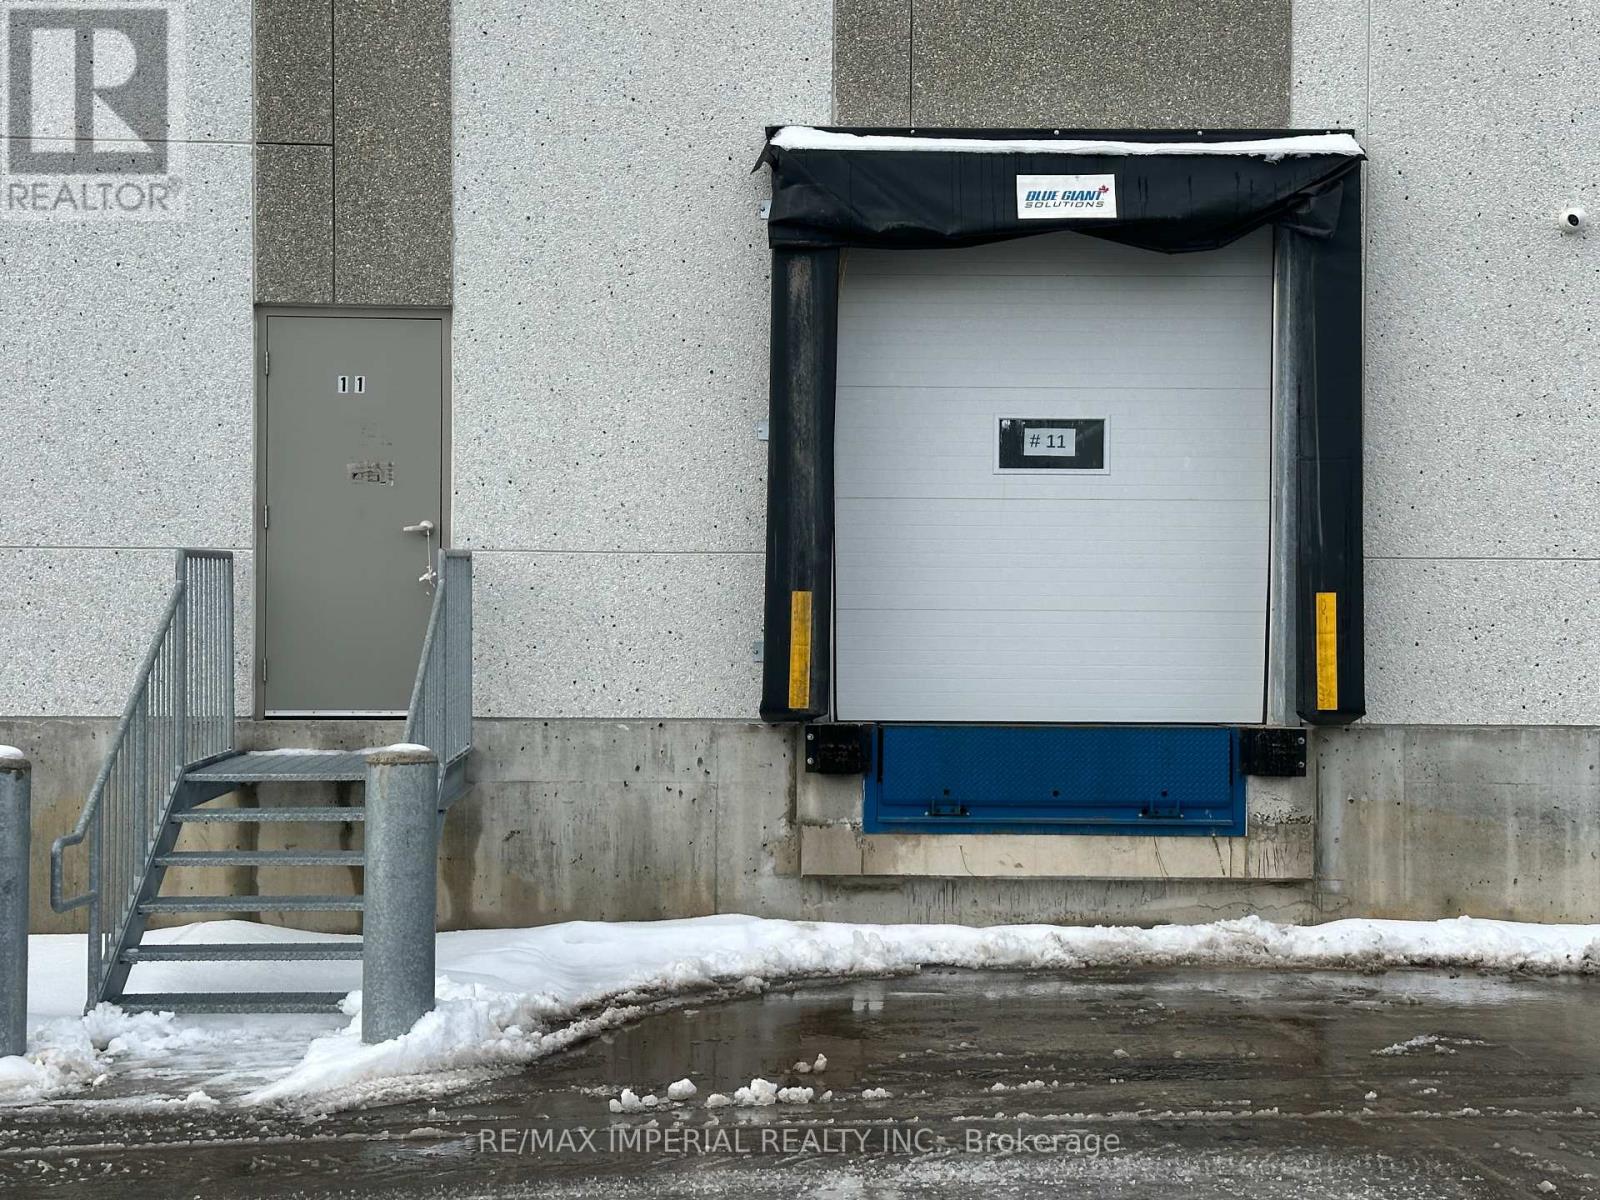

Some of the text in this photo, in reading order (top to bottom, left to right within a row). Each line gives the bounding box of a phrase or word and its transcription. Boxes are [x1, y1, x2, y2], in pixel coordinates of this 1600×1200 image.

[1025, 190, 1101, 202] BLUE GIANT
[340, 376, 363, 393] 11
[1029, 434, 1066, 449] # 11
